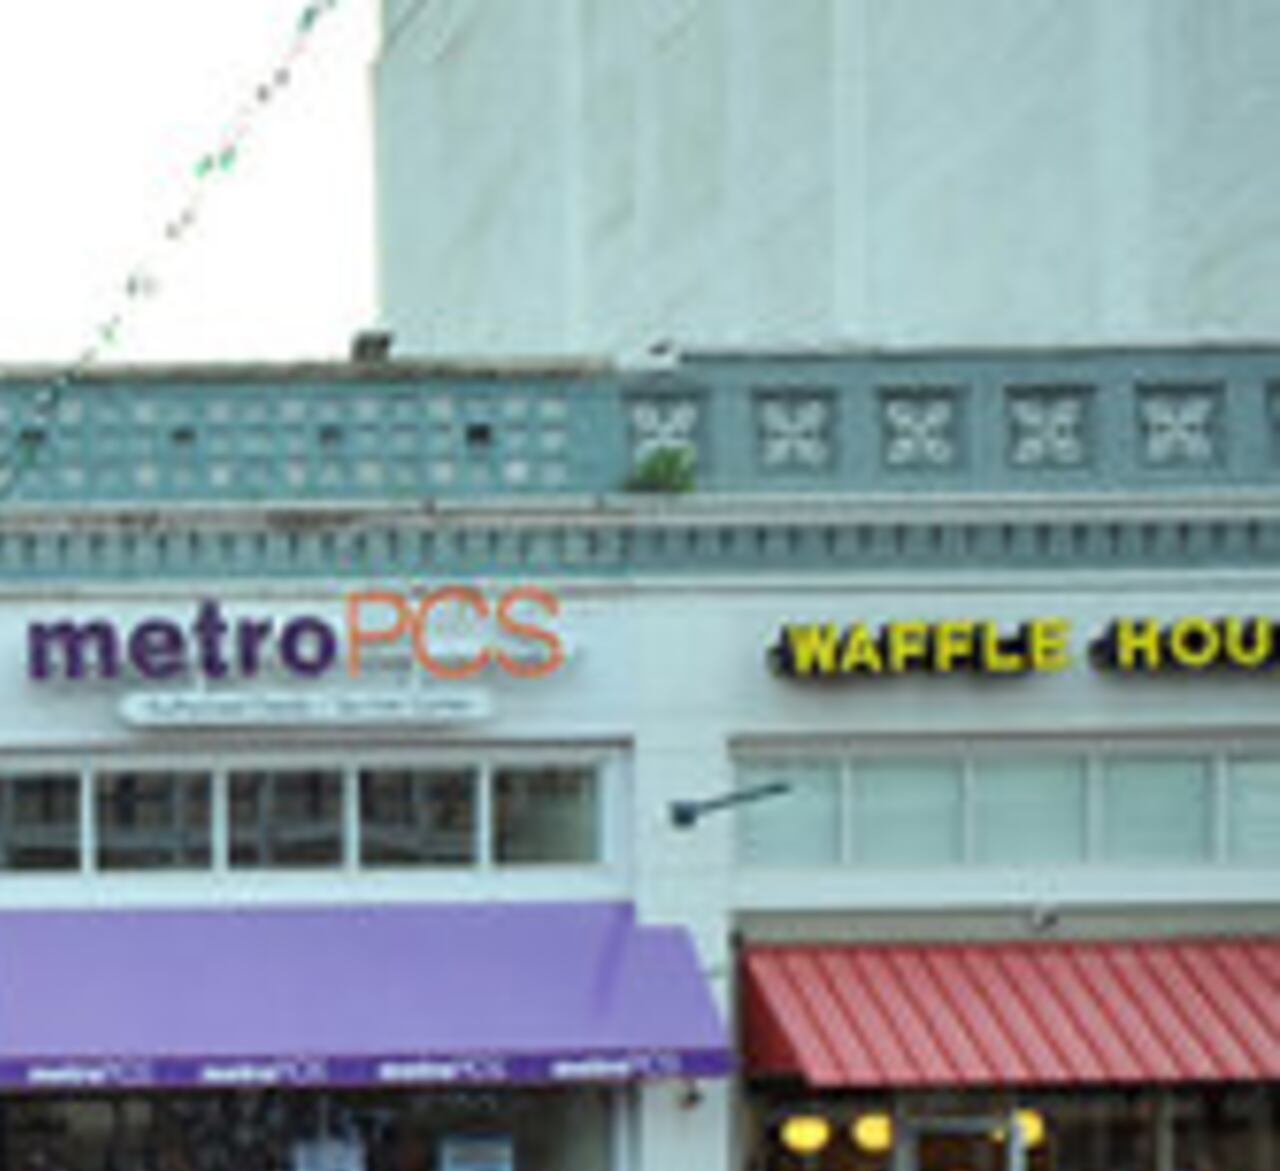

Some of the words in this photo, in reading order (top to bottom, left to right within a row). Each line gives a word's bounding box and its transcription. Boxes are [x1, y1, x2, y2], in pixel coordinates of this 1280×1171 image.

[27, 585, 565, 680] metroPCS
[786, 617, 1073, 674] WAFFLE
[1116, 616, 1274, 669] HOU
